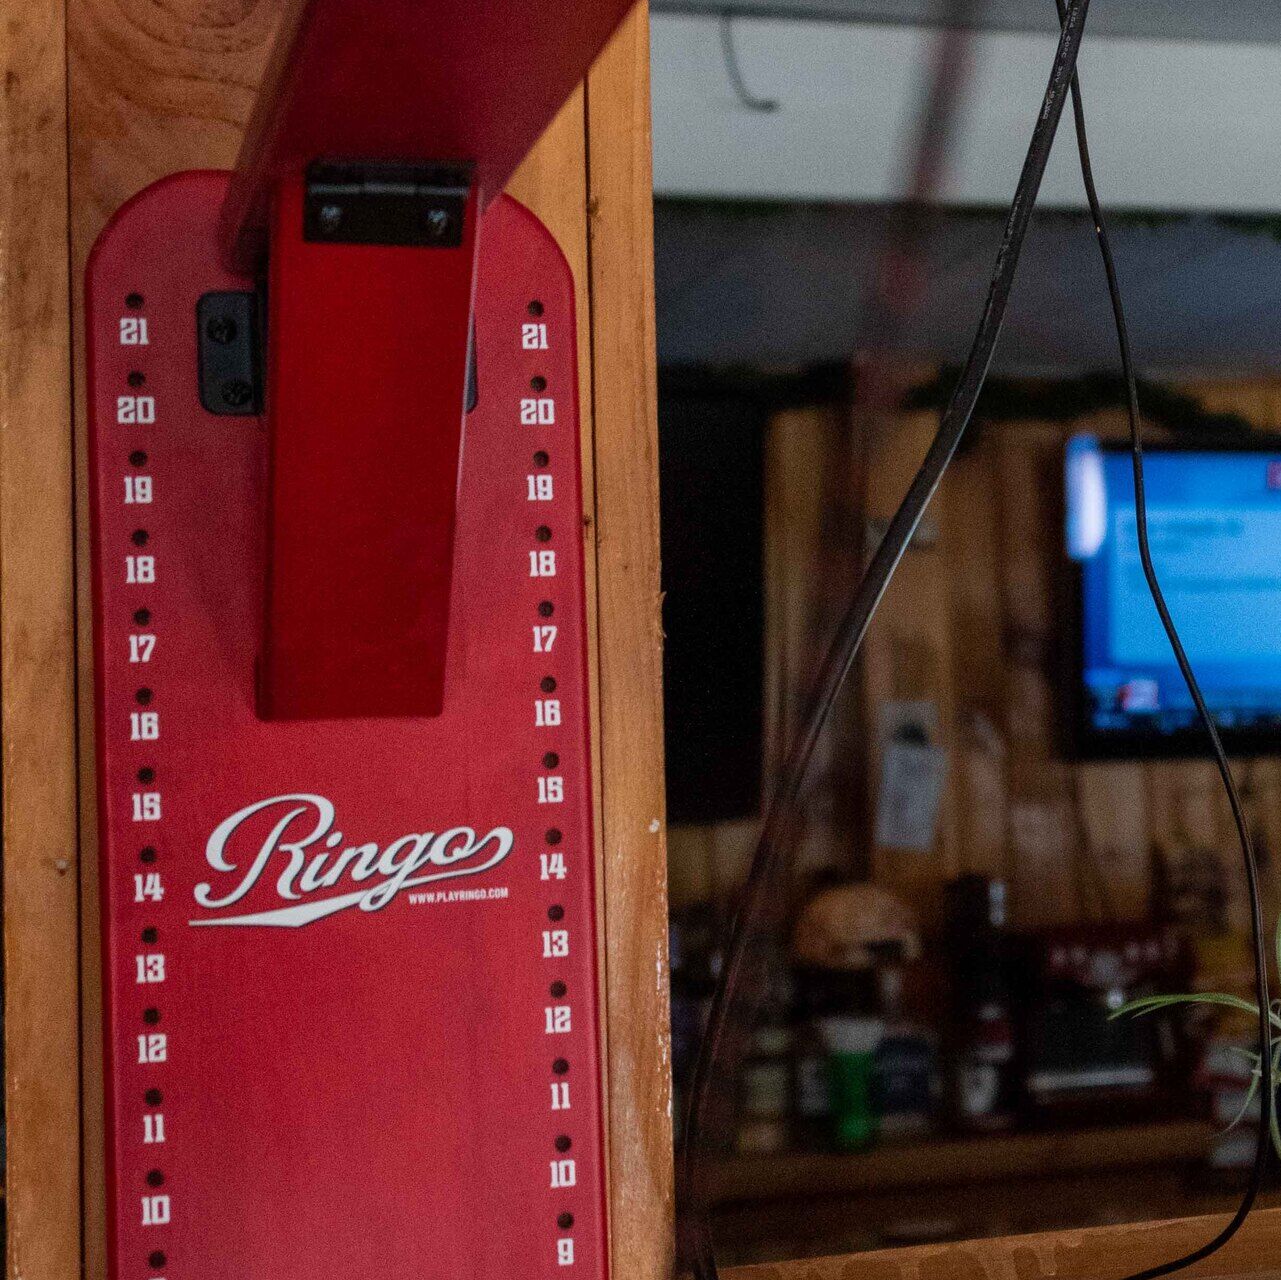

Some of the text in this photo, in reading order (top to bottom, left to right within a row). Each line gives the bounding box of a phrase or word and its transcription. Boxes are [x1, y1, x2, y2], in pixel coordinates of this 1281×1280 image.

[119, 317, 149, 345] 21
[521, 323, 549, 350] 21
[117, 396, 156, 424] 20
[519, 397, 556, 426] 20
[123, 476, 153, 504] 19
[526, 473, 554, 502] 19
[125, 555, 156, 584] 18
[528, 549, 557, 578] 18
[128, 634, 157, 663] 17
[532, 624, 558, 653] 17
[130, 711, 160, 741] 16
[534, 699, 562, 727] 16
[536, 775, 565, 804] 15
[132, 792, 162, 822] 15
[192, 793, 514, 912] Ringo
[539, 852, 568, 881] 14
[133, 873, 165, 902] 14
[408, 886, 509, 905] WWW.PLAYRINGO.COM
[541, 929, 570, 959] 13
[135, 953, 166, 984] 13
[543, 1004, 572, 1035] 12
[137, 1033, 167, 1064] 12
[549, 1081, 572, 1111] 11
[143, 1113, 166, 1144] 11
[549, 1158, 577, 1189] 10
[141, 1194, 171, 1226] 10
[556, 1237, 575, 1267] 9
